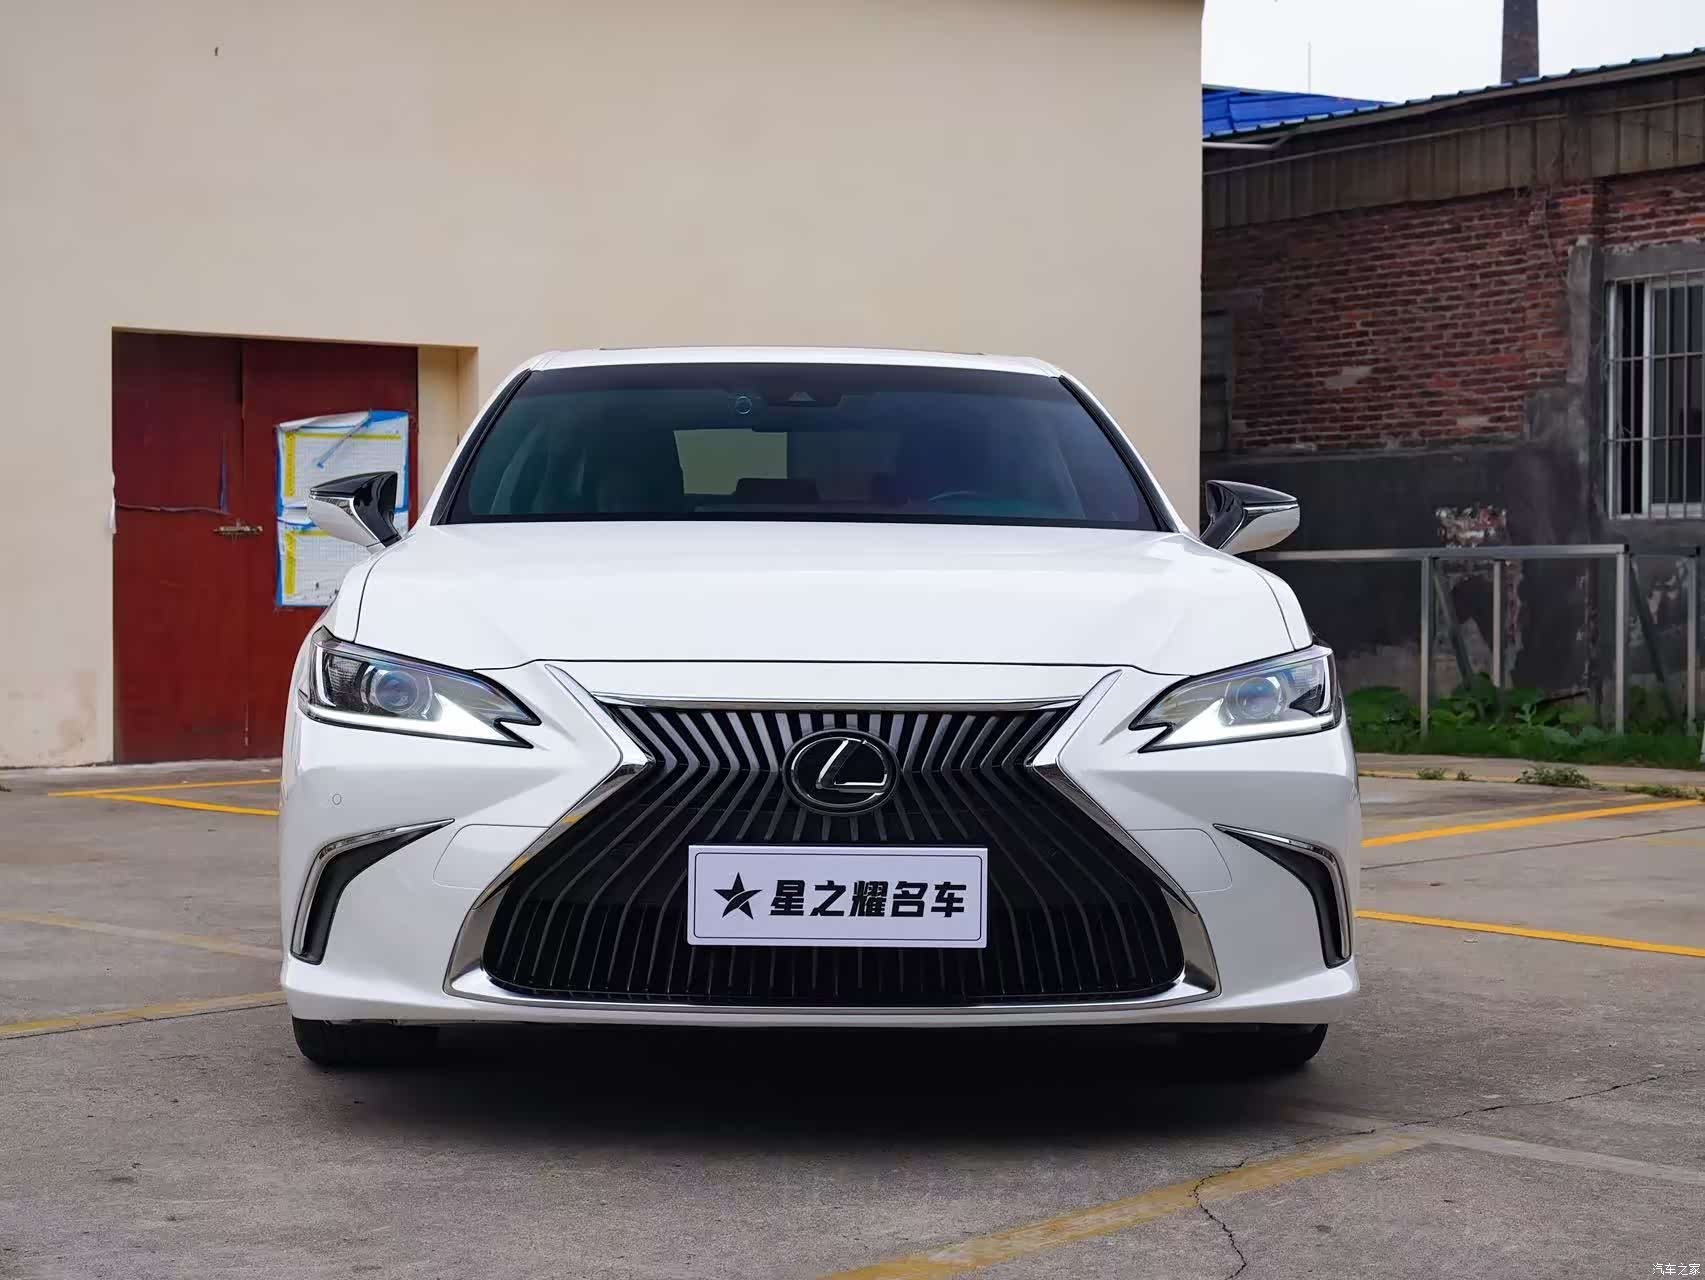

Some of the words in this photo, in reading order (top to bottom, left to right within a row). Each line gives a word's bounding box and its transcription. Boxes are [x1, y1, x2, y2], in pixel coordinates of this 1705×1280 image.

[769, 880, 967, 918] 星之耀名车
